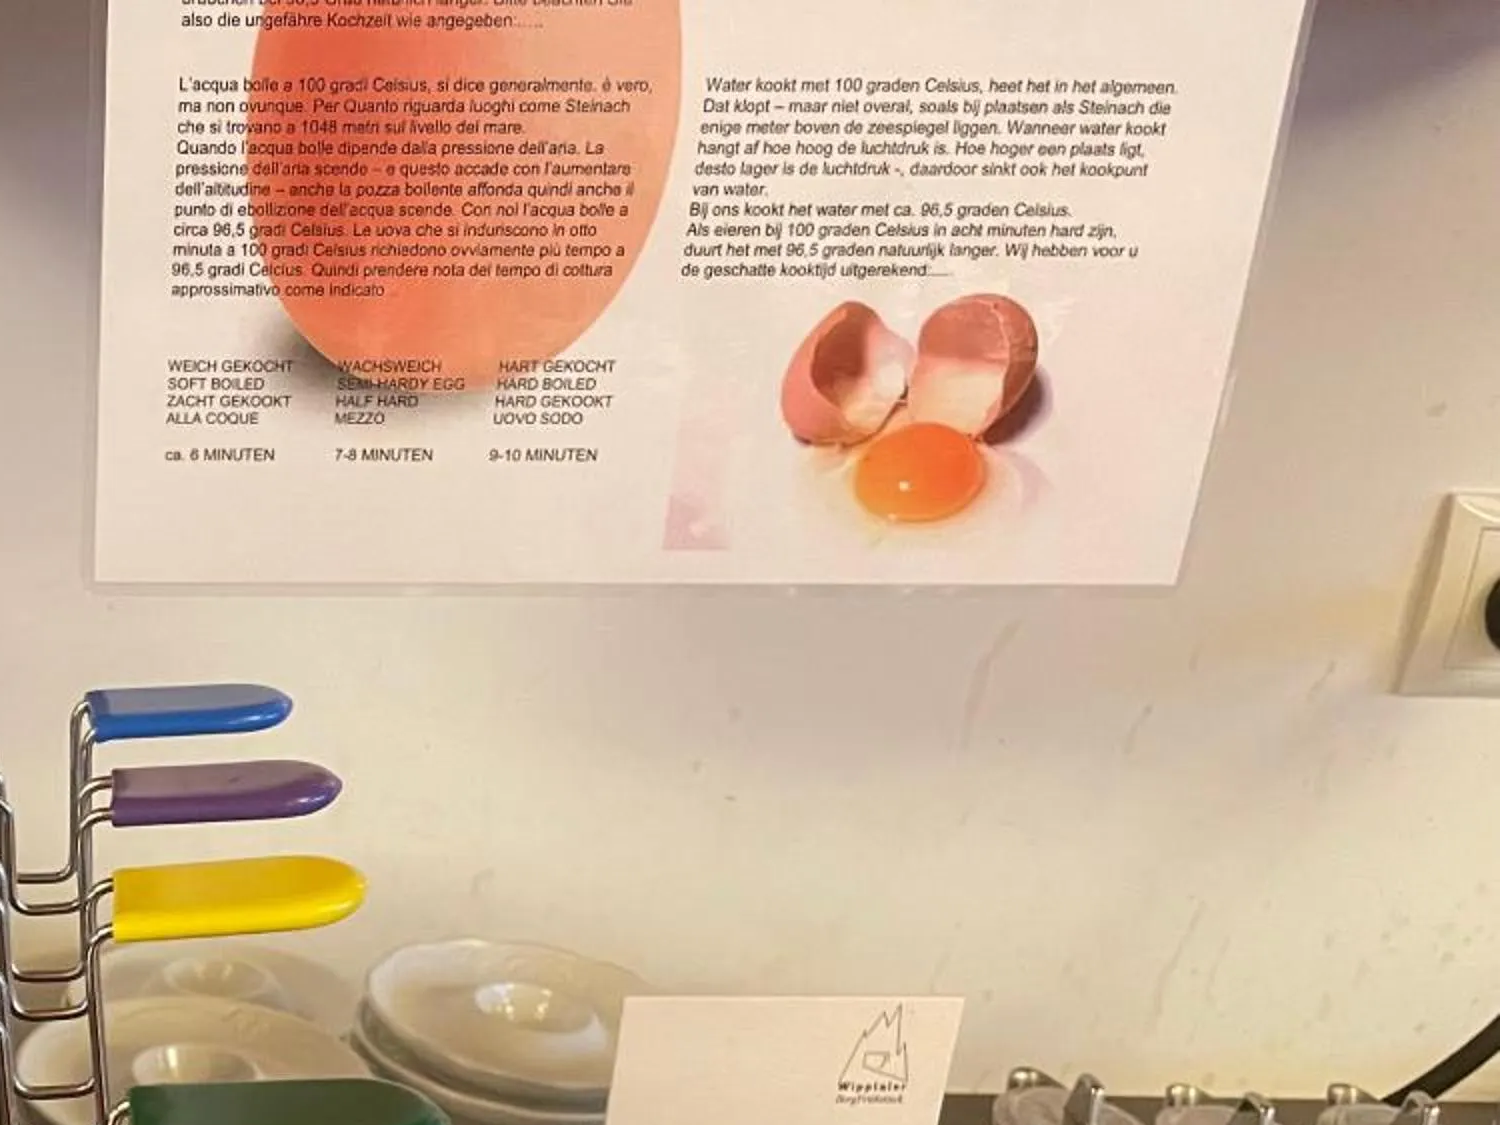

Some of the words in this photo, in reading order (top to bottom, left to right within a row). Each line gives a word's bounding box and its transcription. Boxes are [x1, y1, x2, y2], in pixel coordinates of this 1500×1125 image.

[181, 13, 213, 28] also
[245, 13, 322, 31] ungefähre
[327, 13, 392, 28] Kochzeit
[179, 77, 239, 95] L'acqua
[453, 78, 485, 93] dice
[706, 77, 752, 92] Water
[755, 78, 797, 93] kookt
[866, 78, 920, 96] graden
[989, 78, 1023, 93] heet
[344, 99, 399, 117] Quanto
[403, 99, 465, 117] riguarda
[469, 99, 515, 117] luoghi
[519, 102, 561, 114] come
[565, 99, 631, 114] Steinach
[733, 99, 770, 117] klopt
[788, 102, 828, 114] maar
[831, 99, 859, 114] niet
[984, 100, 1048, 118] plaatsen
[1079, 100, 1145, 115] Steinach
[225, 119, 282, 134] trovano
[303, 120, 337, 135] 1048
[700, 120, 742, 138] enige
[746, 120, 790, 135] meter
[794, 120, 840, 135] boven
[867, 120, 949, 138] zeespiegel
[1007, 121, 1076, 136] Wanneer
[1079, 121, 1122, 136] water
[1125, 121, 1166, 136] kookt
[176, 140, 237, 158] Quando
[241, 140, 294, 158] l'acqua
[337, 140, 397, 158] dipende
[441, 140, 515, 158] pressione
[697, 140, 740, 158] hangt
[795, 140, 833, 159] hoog
[861, 141, 929, 156] luchtdruk
[990, 141, 1034, 159] hoger
[1070, 142, 1115, 160] plaats
[175, 161, 249, 179] pressione
[252, 161, 310, 176] dell'aria
[314, 161, 368, 176] scende
[399, 161, 450, 179] questo
[454, 161, 509, 176] accade
[544, 161, 631, 176] l'aumentare
[740, 161, 779, 179] lager
[822, 161, 891, 176] luchtdruk
[910, 161, 978, 176] daardoor
[1079, 162, 1148, 180] kookpunt
[289, 182, 334, 197] anche
[404, 182, 463, 197] bollente
[527, 182, 573, 200] quindi
[576, 182, 622, 197] anche
[173, 202, 216, 220] punto
[237, 202, 316, 217] ebollizione
[320, 202, 395, 220] dell'acqua
[523, 202, 575, 220] l'acqua
[744, 202, 785, 217] kookt
[816, 202, 858, 217] water
[921, 202, 953, 219] 96,5
[957, 202, 1009, 221] graden
[173, 222, 209, 237] circa
[213, 222, 245, 239] 96,5
[375, 225, 411, 237] uova
[463, 222, 548, 237] induriscono
[569, 222, 597, 237] otto
[714, 222, 761, 237] eieren
[818, 222, 871, 240] graden
[875, 223, 929, 238] Celsius
[951, 223, 983, 238] acht
[987, 223, 1046, 238] minuten
[1050, 223, 1085, 238] hard
[313, 242, 366, 257] Celsius
[370, 242, 449, 257] richiedono
[448, 242, 535, 257] ovviamente
[565, 242, 612, 260] tempo
[683, 242, 723, 257] duurt
[786, 242, 818, 259] 96,5
[822, 242, 875, 260] graden
[878, 243, 945, 261] natuurlijk
[1031, 243, 1088, 258] hebben
[1093, 246, 1125, 258] voor
[171, 262, 205, 279] 96,5
[311, 262, 359, 280] Quindi
[363, 262, 428, 280] prendere
[431, 262, 465, 277] nota
[495, 262, 541, 280] tempo
[562, 262, 613, 277] cottura
[703, 262, 776, 280] geschatte
[285, 285, 324, 297] come
[168, 359, 218, 373] WEICH
[221, 359, 291, 373] GEKOCHT
[338, 359, 443, 373] WACHSWEICH
[499, 359, 538, 373] HART
[543, 359, 616, 373] GEKOCHT
[167, 377, 206, 391] SOFT
[211, 377, 265, 391] BOILED
[433, 377, 465, 391] EGG
[497, 377, 539, 391] HARD
[542, 377, 597, 391] BOILED
[166, 394, 215, 408] ZACHT
[219, 394, 290, 408] GEKOOKT
[377, 394, 419, 408] HARD
[495, 394, 537, 408] HARD
[540, 394, 612, 408] GEKOOKT
[166, 411, 202, 425] ALLA
[334, 411, 385, 425] MEZZO
[540, 411, 584, 425] SODO
[165, 451, 186, 462] ca.
[190, 448, 199, 462] 6
[203, 448, 275, 462] MINUTEN
[336, 448, 357, 462] 7-8
[361, 448, 433, 462] MINUTEN
[489, 448, 521, 462] 9-10
[525, 448, 598, 462] MINUTEN
